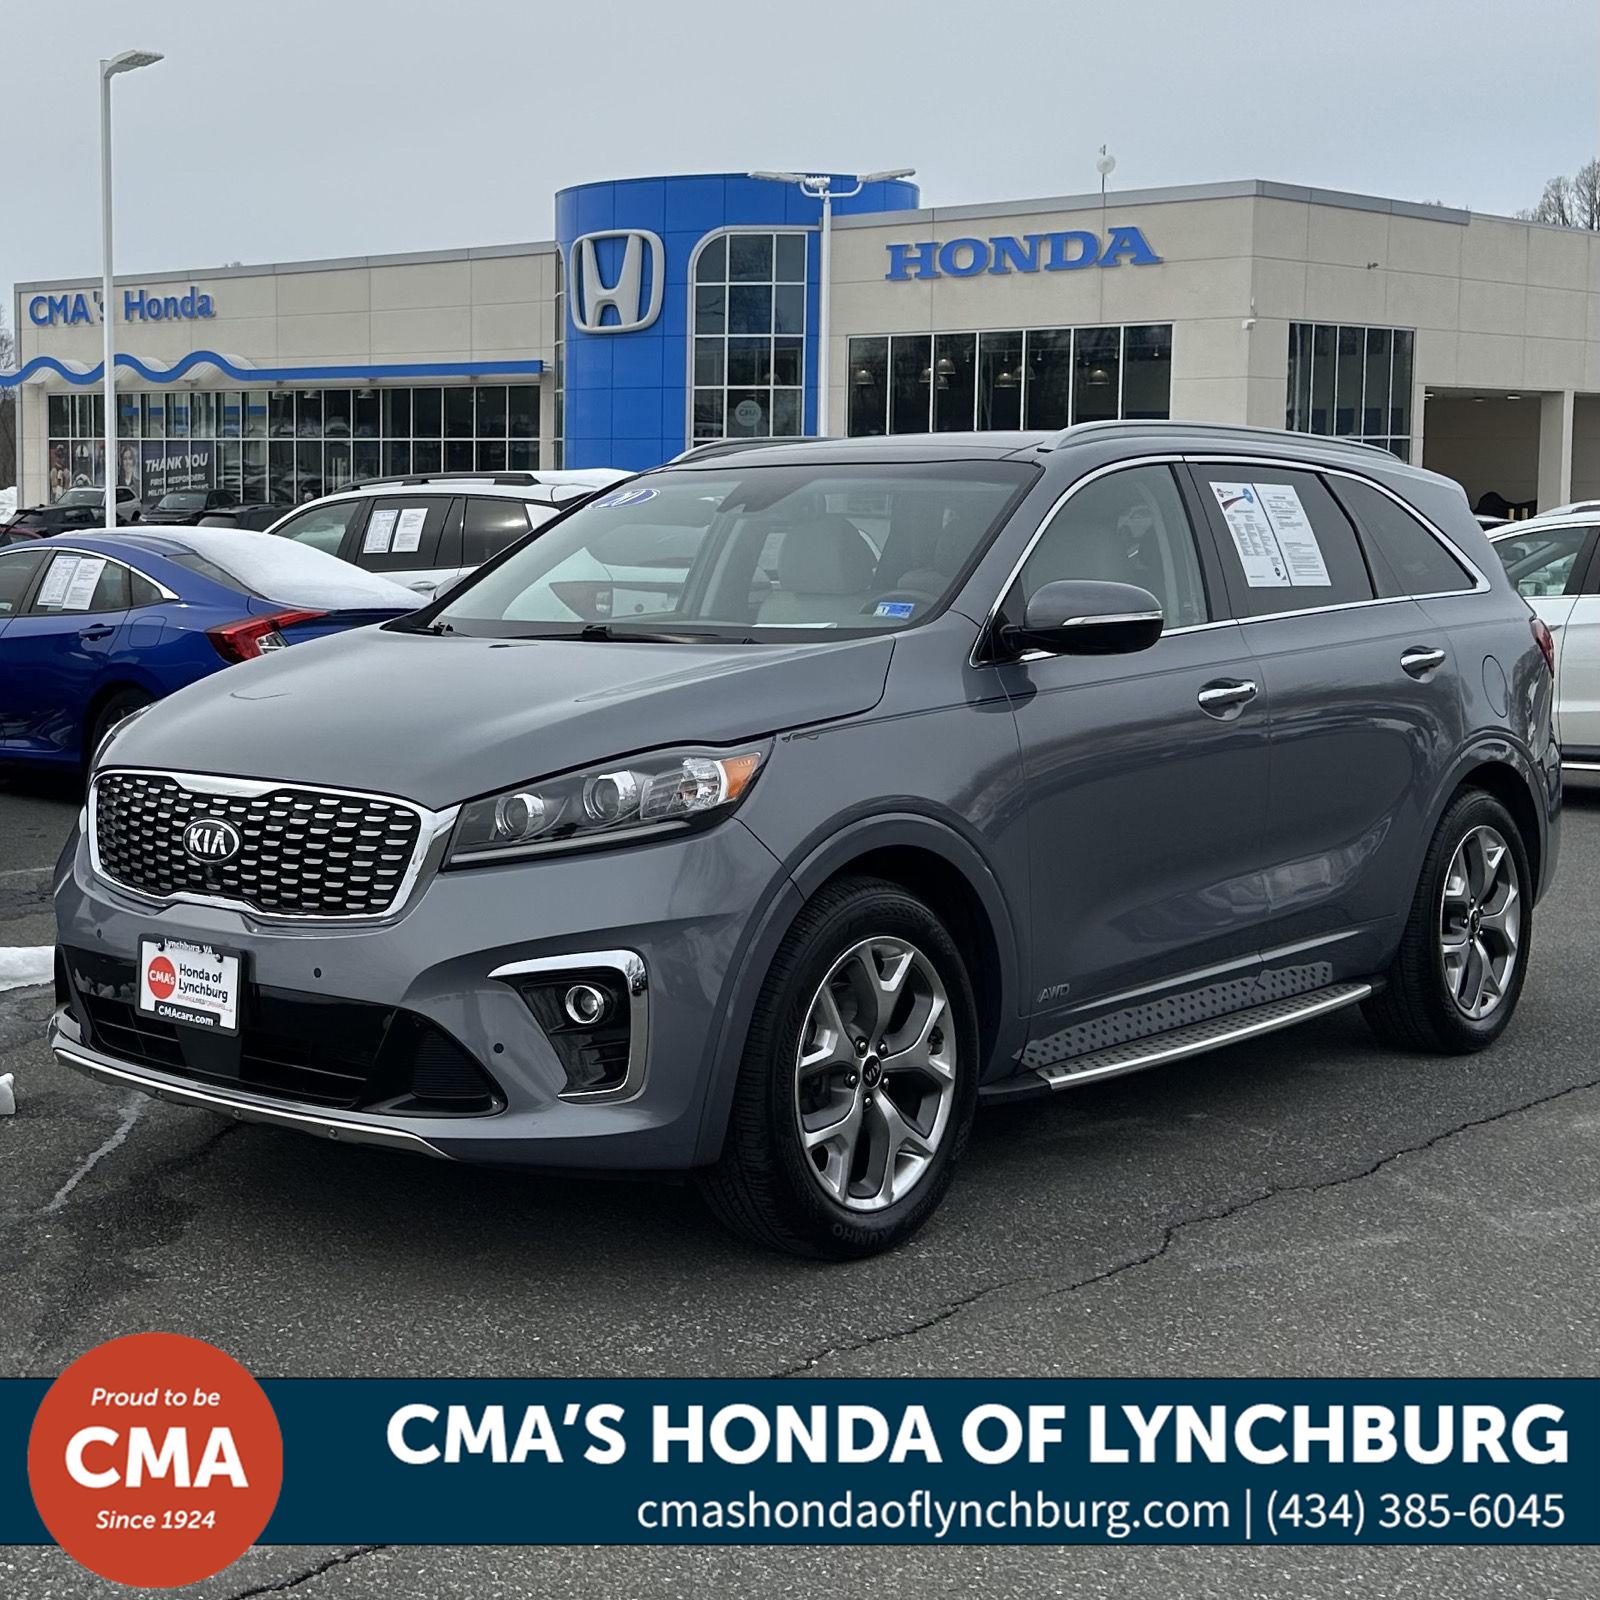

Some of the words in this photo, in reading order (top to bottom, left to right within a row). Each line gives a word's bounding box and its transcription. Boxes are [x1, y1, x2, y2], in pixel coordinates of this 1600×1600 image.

[885, 226, 1164, 281] HONDA
[124, 286, 215, 322] Honda
[145, 455, 183, 473] THANK
[184, 452, 209, 468] YOU
[189, 827, 227, 855] KIA
[202, 945, 213, 954] VA
[149, 969, 175, 986] CMA's
[179, 963, 210, 981] Honda
[212, 971, 223, 984] of
[178, 978, 228, 1003] Lynchburg
[1037, 983, 1070, 1003] AWD
[158, 1005, 214, 1027] CMAcars.com
